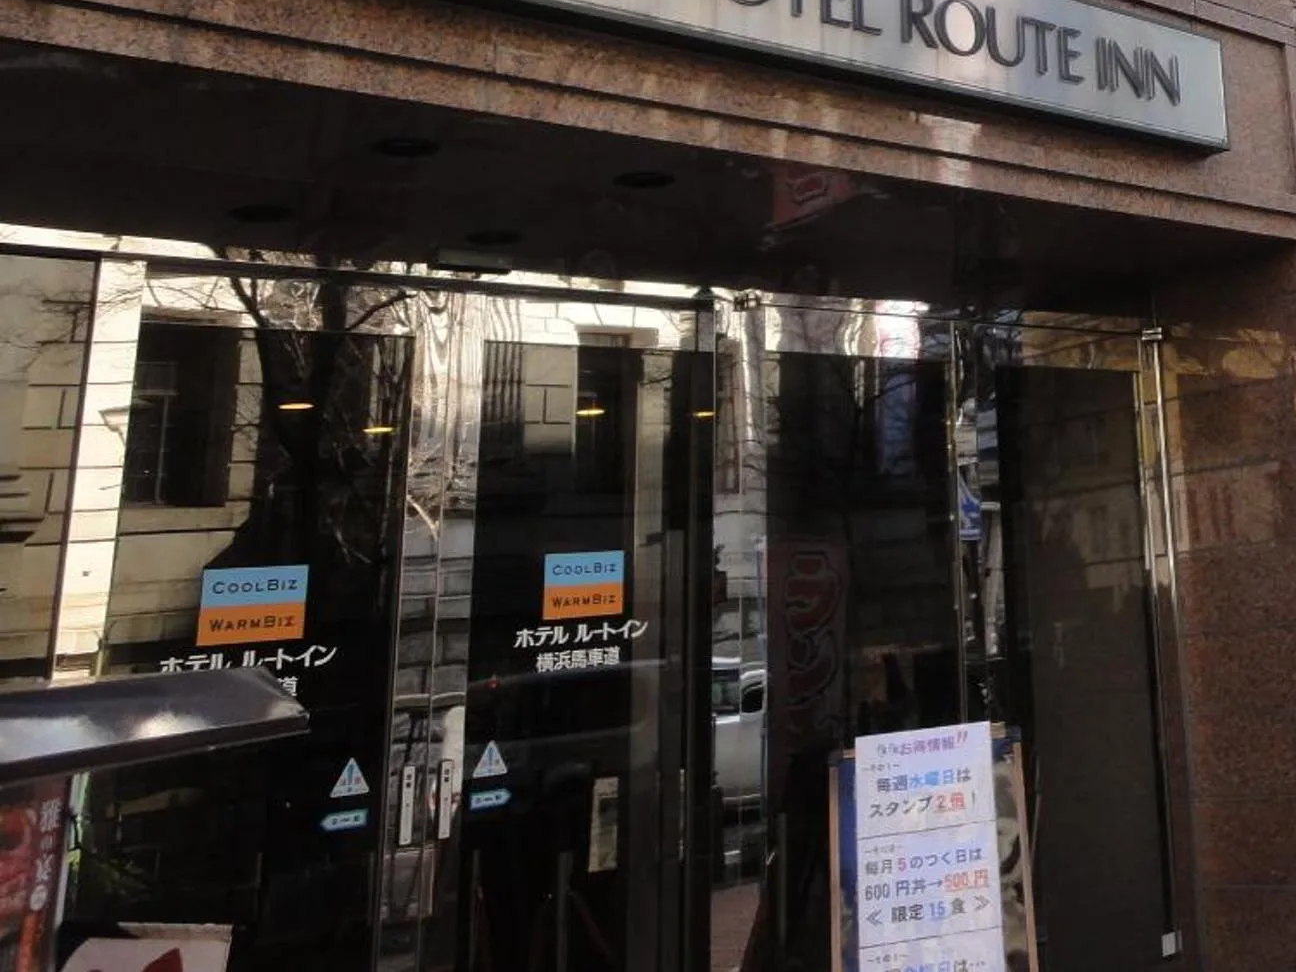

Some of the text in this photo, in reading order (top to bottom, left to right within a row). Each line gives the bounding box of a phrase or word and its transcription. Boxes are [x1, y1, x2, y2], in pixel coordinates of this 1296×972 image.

[1095, 36, 1181, 107] INN
[514, 619, 649, 648] ホテル ルートイン
[536, 645, 621, 673] 横浜馬車道
[876, 767, 972, 793] 毎週水曜日は
